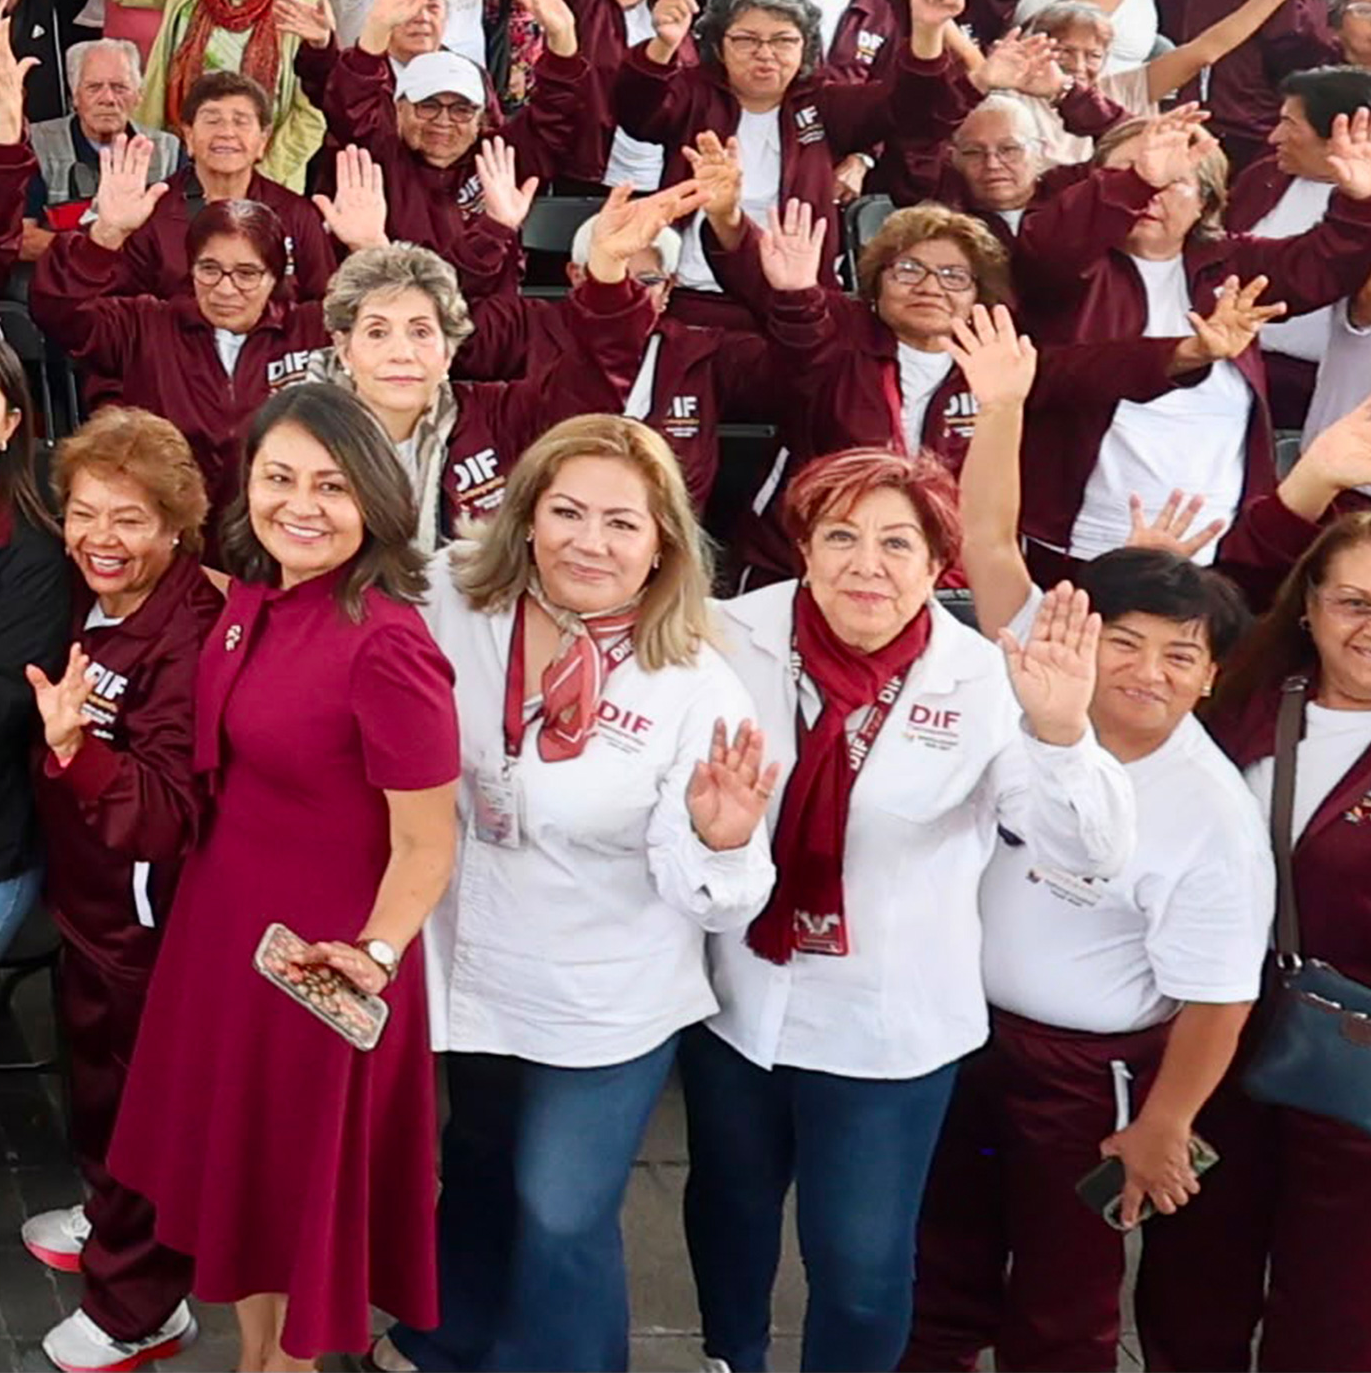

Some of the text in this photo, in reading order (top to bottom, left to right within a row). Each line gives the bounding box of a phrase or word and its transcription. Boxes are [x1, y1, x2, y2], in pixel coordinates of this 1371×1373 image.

[796, 105, 819, 127] IF
[268, 350, 309, 378] DIF
[671, 396, 697, 417] IF
[83, 661, 128, 700] DIF
[597, 699, 654, 735] DIF
[909, 698, 962, 724] DIF
